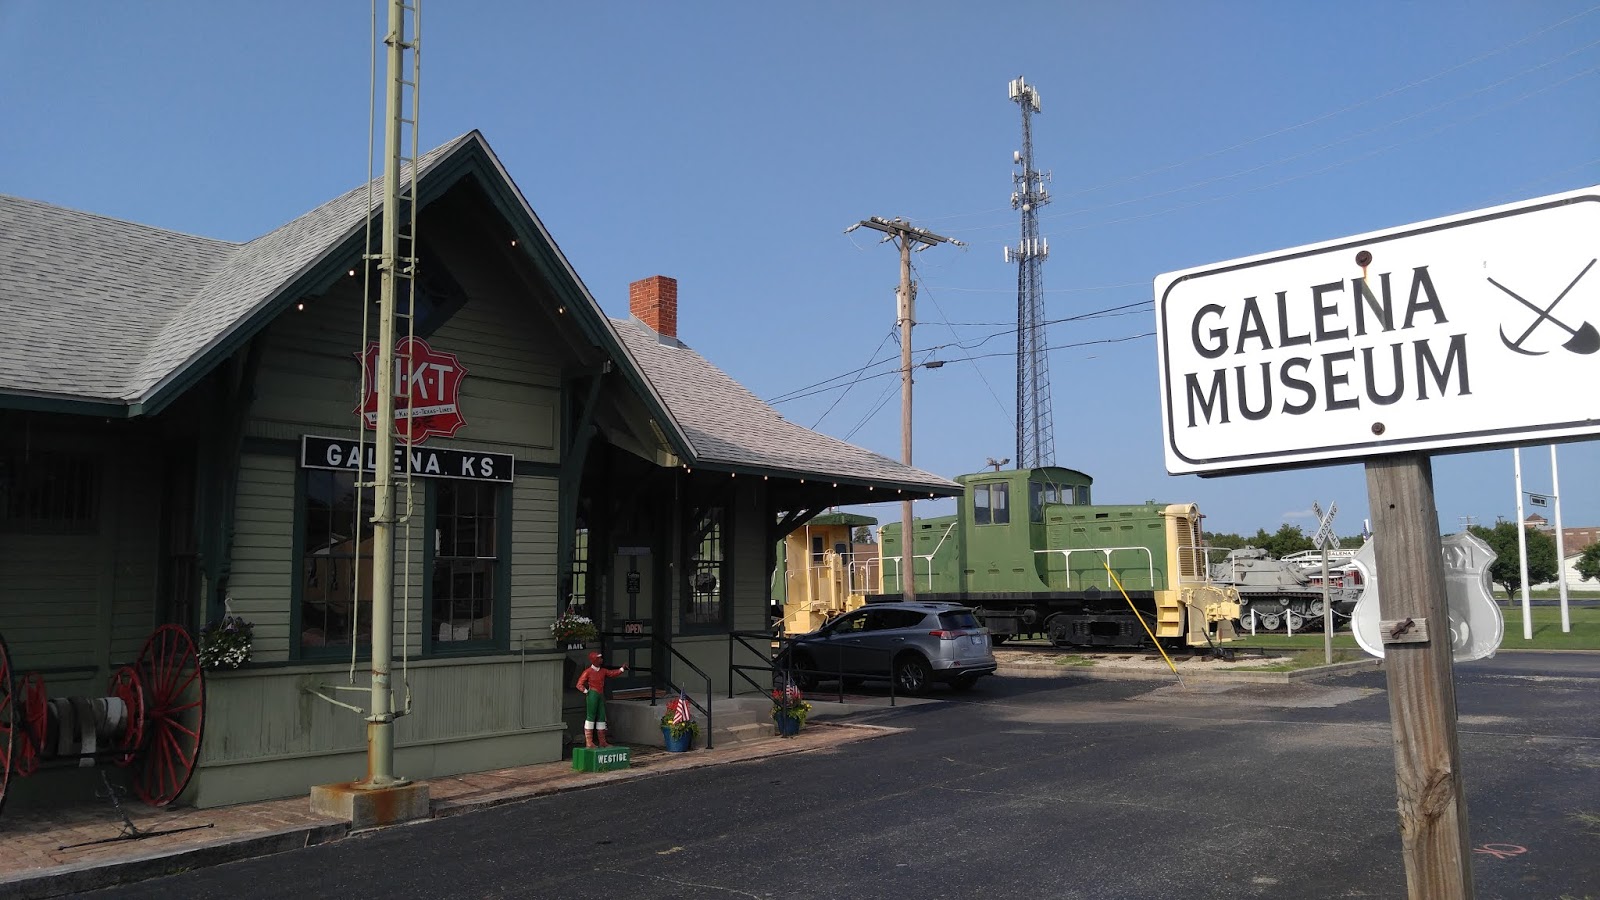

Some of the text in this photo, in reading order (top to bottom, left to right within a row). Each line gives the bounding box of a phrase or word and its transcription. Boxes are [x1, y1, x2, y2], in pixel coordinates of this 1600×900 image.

[1191, 265, 1449, 359] GALENA
[1183, 333, 1473, 428] MUSEUM
[1315, 505, 1338, 545] CROSSING
[625, 624, 643, 634] OPEN
